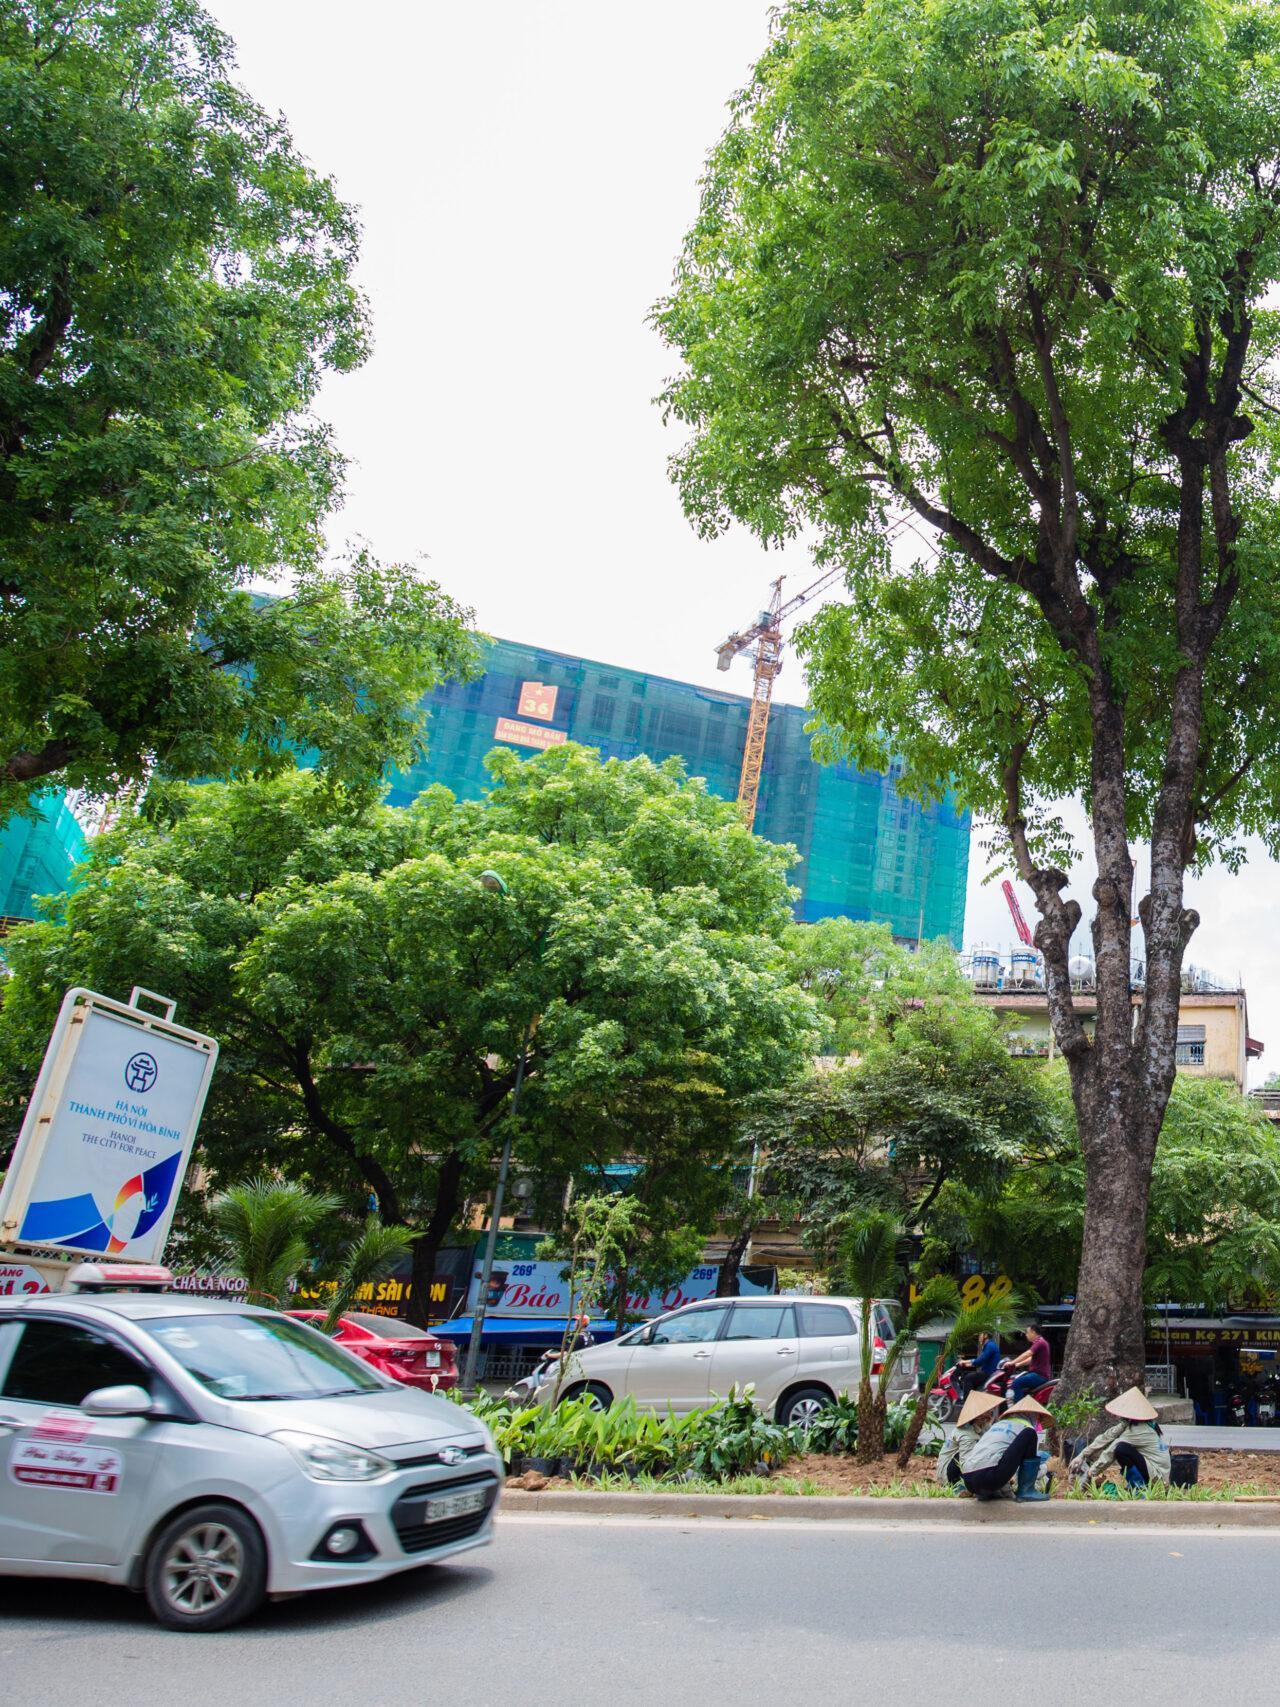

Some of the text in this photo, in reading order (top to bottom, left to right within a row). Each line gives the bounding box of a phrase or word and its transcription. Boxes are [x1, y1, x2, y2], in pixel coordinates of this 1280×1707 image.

[69, 1101, 105, 1120] THÀNH
[82, 1133, 158, 1159] THE CITY FOR PEACE
[110, 1130, 137, 1144] HANOI
[503, 1284, 561, 1308] Bảo
[1221, 1331, 1249, 1341] 271
